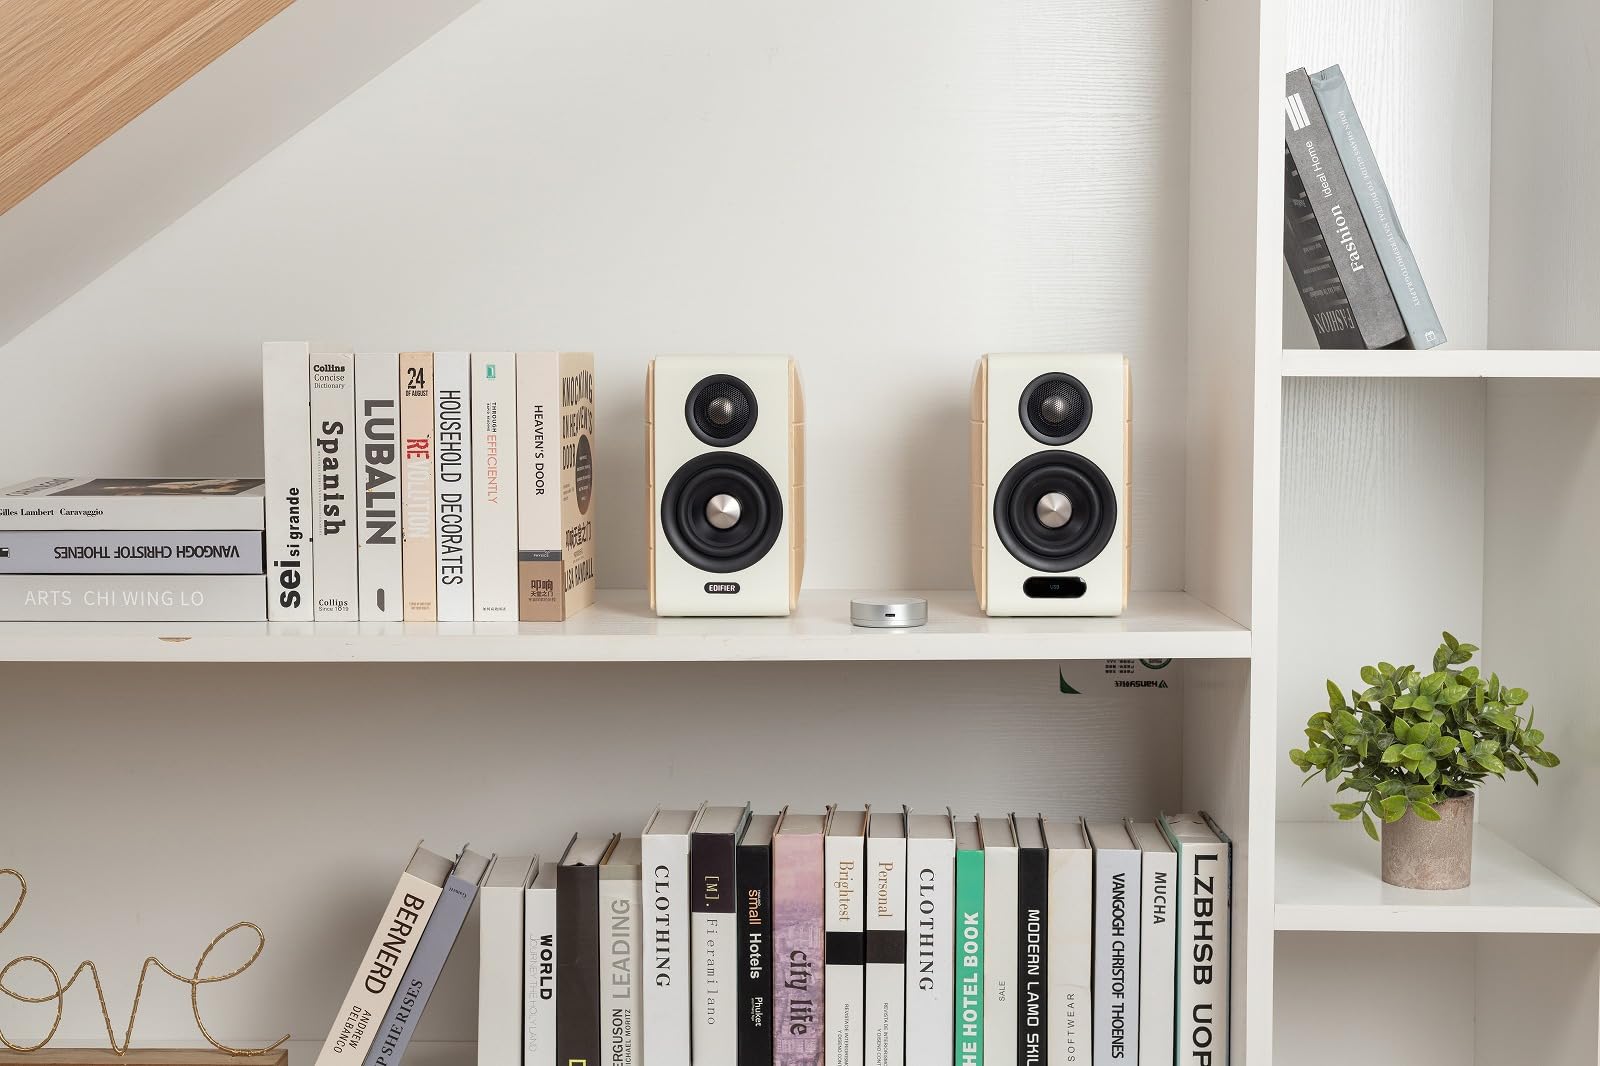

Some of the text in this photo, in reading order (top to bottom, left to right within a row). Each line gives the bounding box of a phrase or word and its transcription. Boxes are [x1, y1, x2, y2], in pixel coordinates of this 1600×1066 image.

[1338, 110, 1350, 131] JOHN
[1356, 155, 1368, 181] GUIDE
[1365, 179, 1374, 192] TO
[1305, 140, 1365, 272] Fashion Ideal Home
[1369, 189, 1386, 223] DIGITAL
[313, 364, 346, 373] Collins
[314, 374, 345, 382] Concise
[407, 367, 425, 389] 24
[562, 369, 593, 408] KNOCKING
[317, 421, 346, 535] Spanish
[364, 400, 397, 544] LUBALIN
[487, 434, 498, 504] EFFICIENTLY
[534, 405, 545, 496] HEAVEN'S DOOR
[562, 443, 576, 470] DOOR
[20, 507, 54, 516] Lambert
[59, 507, 104, 518] Caravaggio
[439, 390, 463, 585] HOUSEHOLD DECORATES
[54, 545, 240, 559] VANGOGH CHRISTOF THOENES
[273, 487, 303, 609] sei si grande
[564, 557, 594, 593] LISA RANDALL
[25, 590, 204, 607] ARTS CHI WING LO
[531, 579, 554, 591] 叩响
[709, 584, 736, 592] EDIFIER
[834, 860, 855, 922] Brightest
[877, 861, 894, 918] Personal
[1153, 872, 1167, 925] MUCHA
[364, 892, 424, 995] BERNERD
[611, 899, 631, 999] LEADING
[654, 865, 671, 988] CLOTHING
[748, 889, 763, 979] small Hotels
[919, 868, 935, 991] CLOTHING
[963, 912, 979, 967] BOOK
[1027, 909, 1040, 976] MODERN
[1193, 854, 1219, 985] LZBHSB
[0, 868, 291, 1056] ove
[529, 981, 538, 999] THE
[540, 934, 553, 1000] WORLD
[706, 918, 718, 1026] Fieramilano
[1111, 872, 1125, 1059] VANGOGH CHRISTOF THOENES
[381, 1023, 404, 1056] SHE
[395, 979, 423, 1024] RISES
[754, 996, 764, 1027] Phuket
[785, 950, 814, 1036] city life
[962, 973, 978, 1037] HOTEL
[1026, 981, 1040, 1027] LAMO
[333, 1005, 362, 1054] DELBANCO
[348, 1009, 372, 1050] ANDREW
[1067, 993, 1076, 1062] SOFTWEAR
